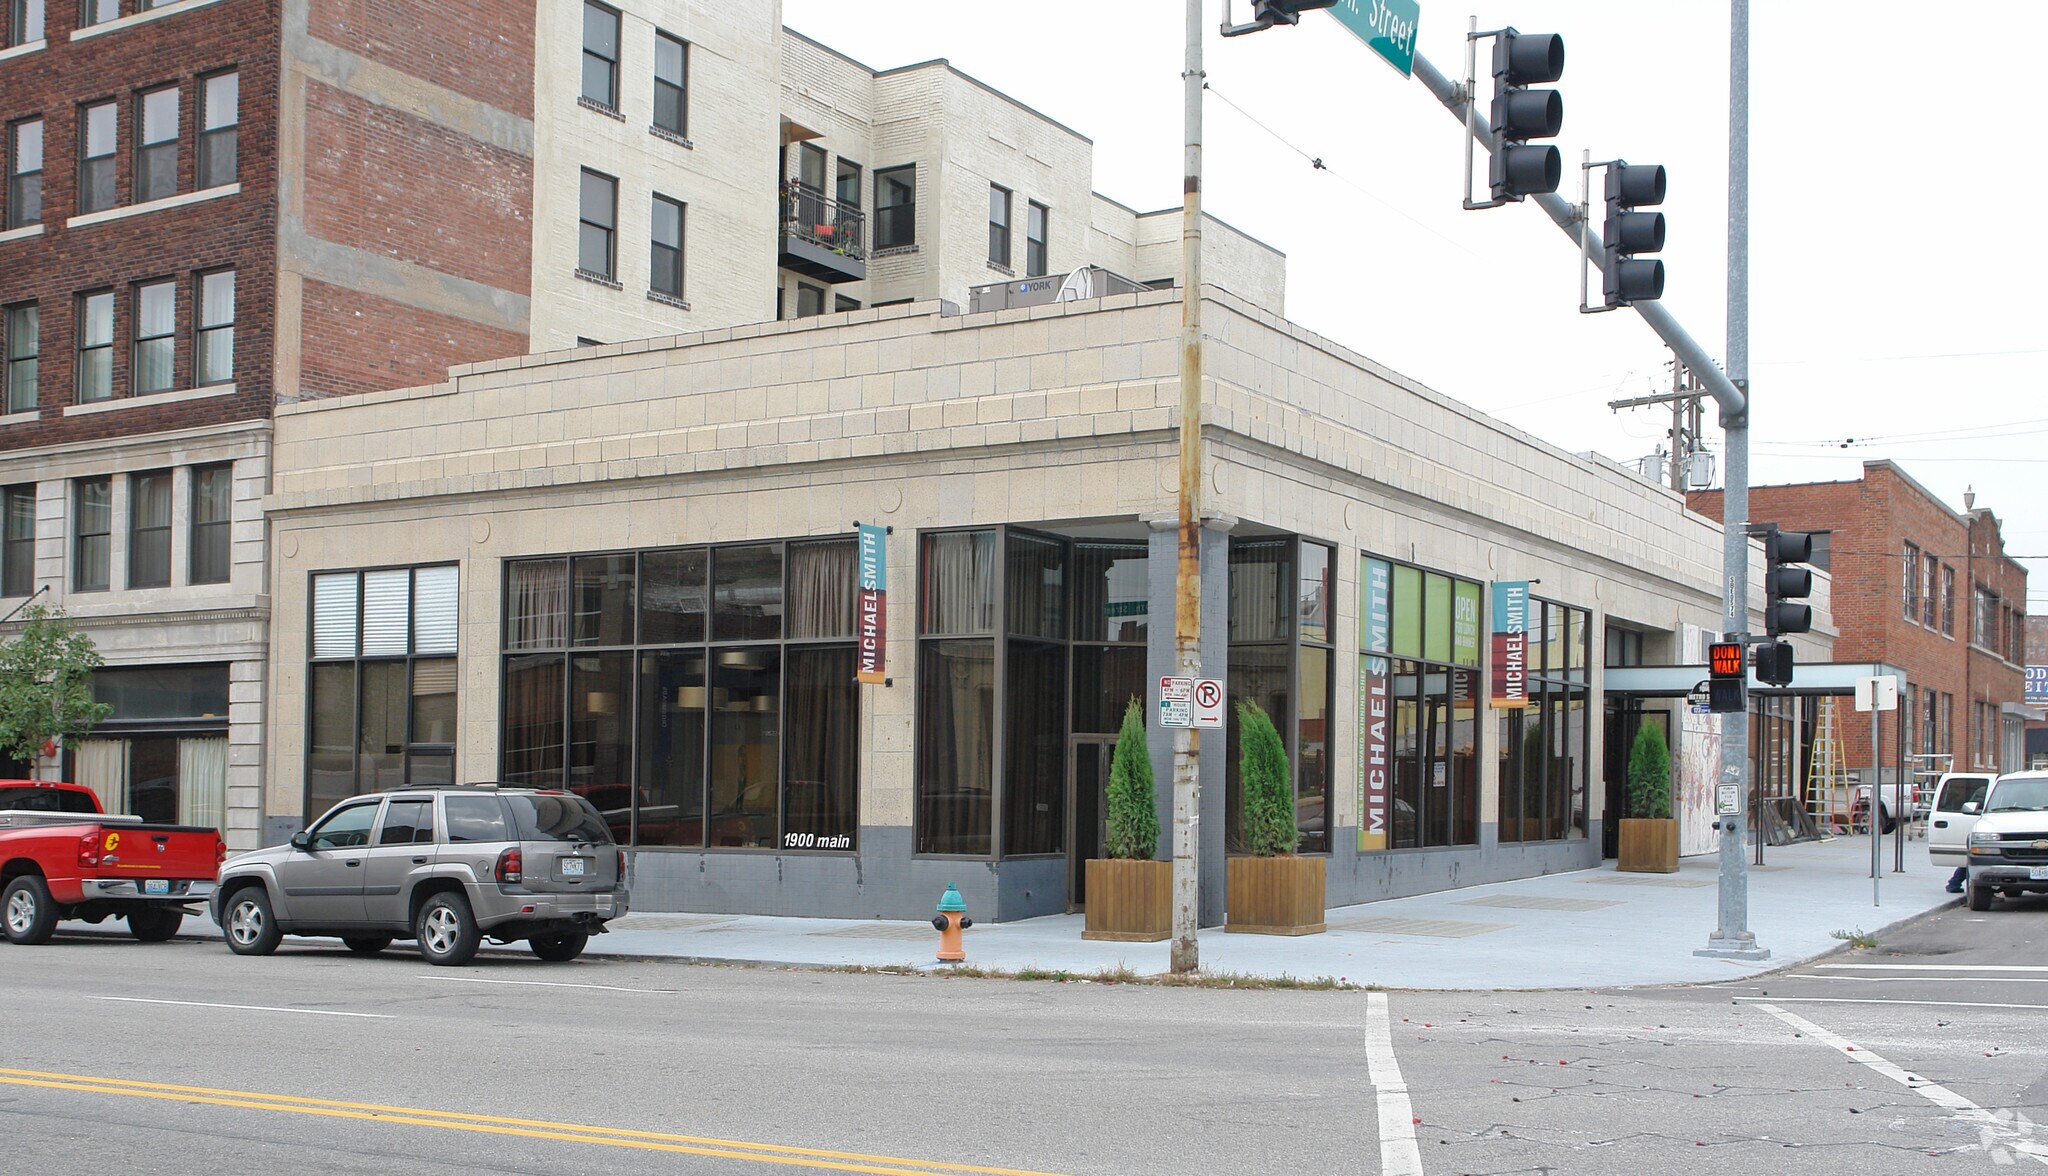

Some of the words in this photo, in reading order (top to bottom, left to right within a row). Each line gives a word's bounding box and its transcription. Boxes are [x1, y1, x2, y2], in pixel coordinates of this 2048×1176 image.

[1369, 0, 1413, 56] Street
[1028, 281, 1051, 292] YORK
[862, 533, 877, 674] MICHAELSMITH
[1455, 596, 1476, 622] OPEN
[1505, 587, 1524, 700] MICHAELSMITH
[1713, 659, 1741, 674] WALK
[784, 832, 814, 847] 1900
[816, 834, 850, 848] main
